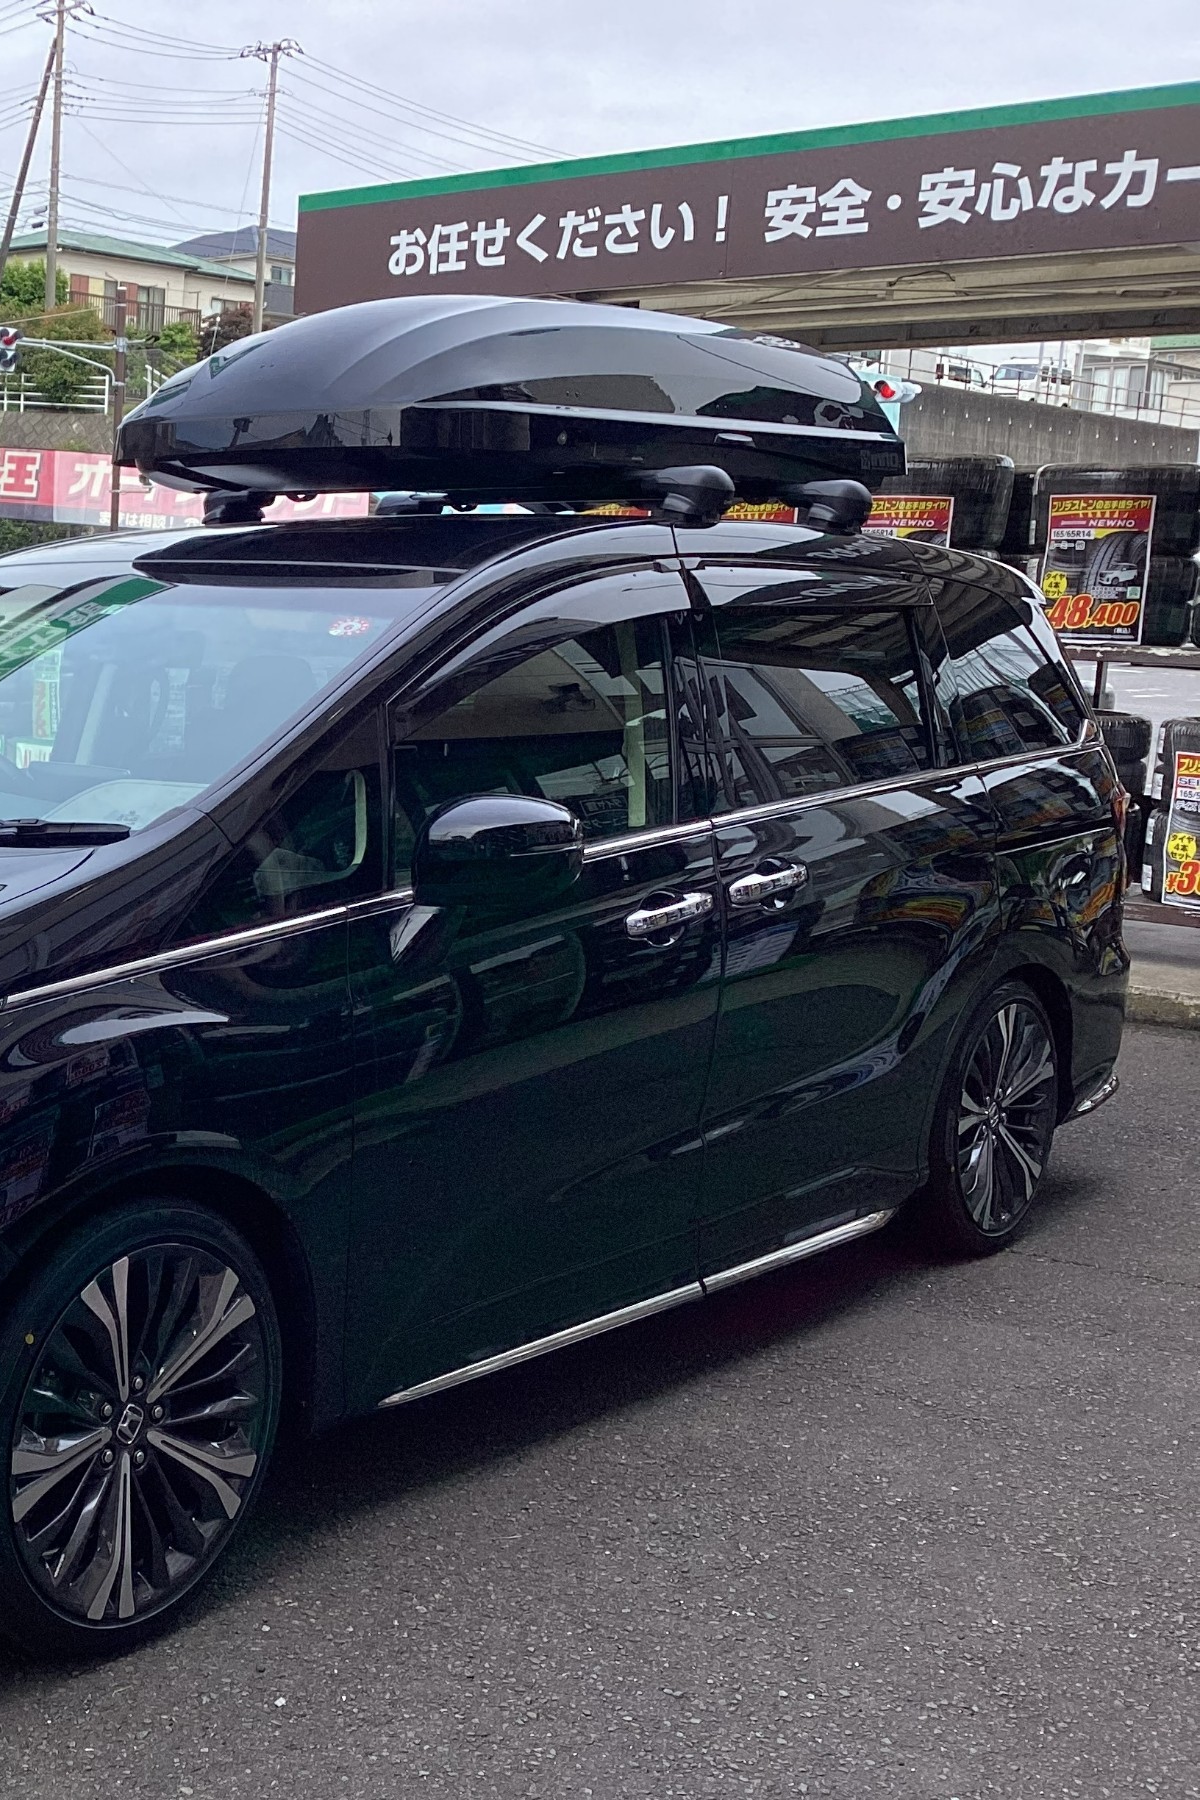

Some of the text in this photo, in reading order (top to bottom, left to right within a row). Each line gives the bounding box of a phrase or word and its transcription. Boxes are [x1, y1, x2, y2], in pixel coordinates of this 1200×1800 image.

[388, 194, 729, 276] お任せください!
[891, 519, 935, 527] NEWNO
[1088, 519, 1136, 528] NEWNO
[1053, 530, 1092, 538] 165/65R14
[1045, 573, 1066, 581] タイヤ
[1171, 834, 1194, 844] タイヤ
